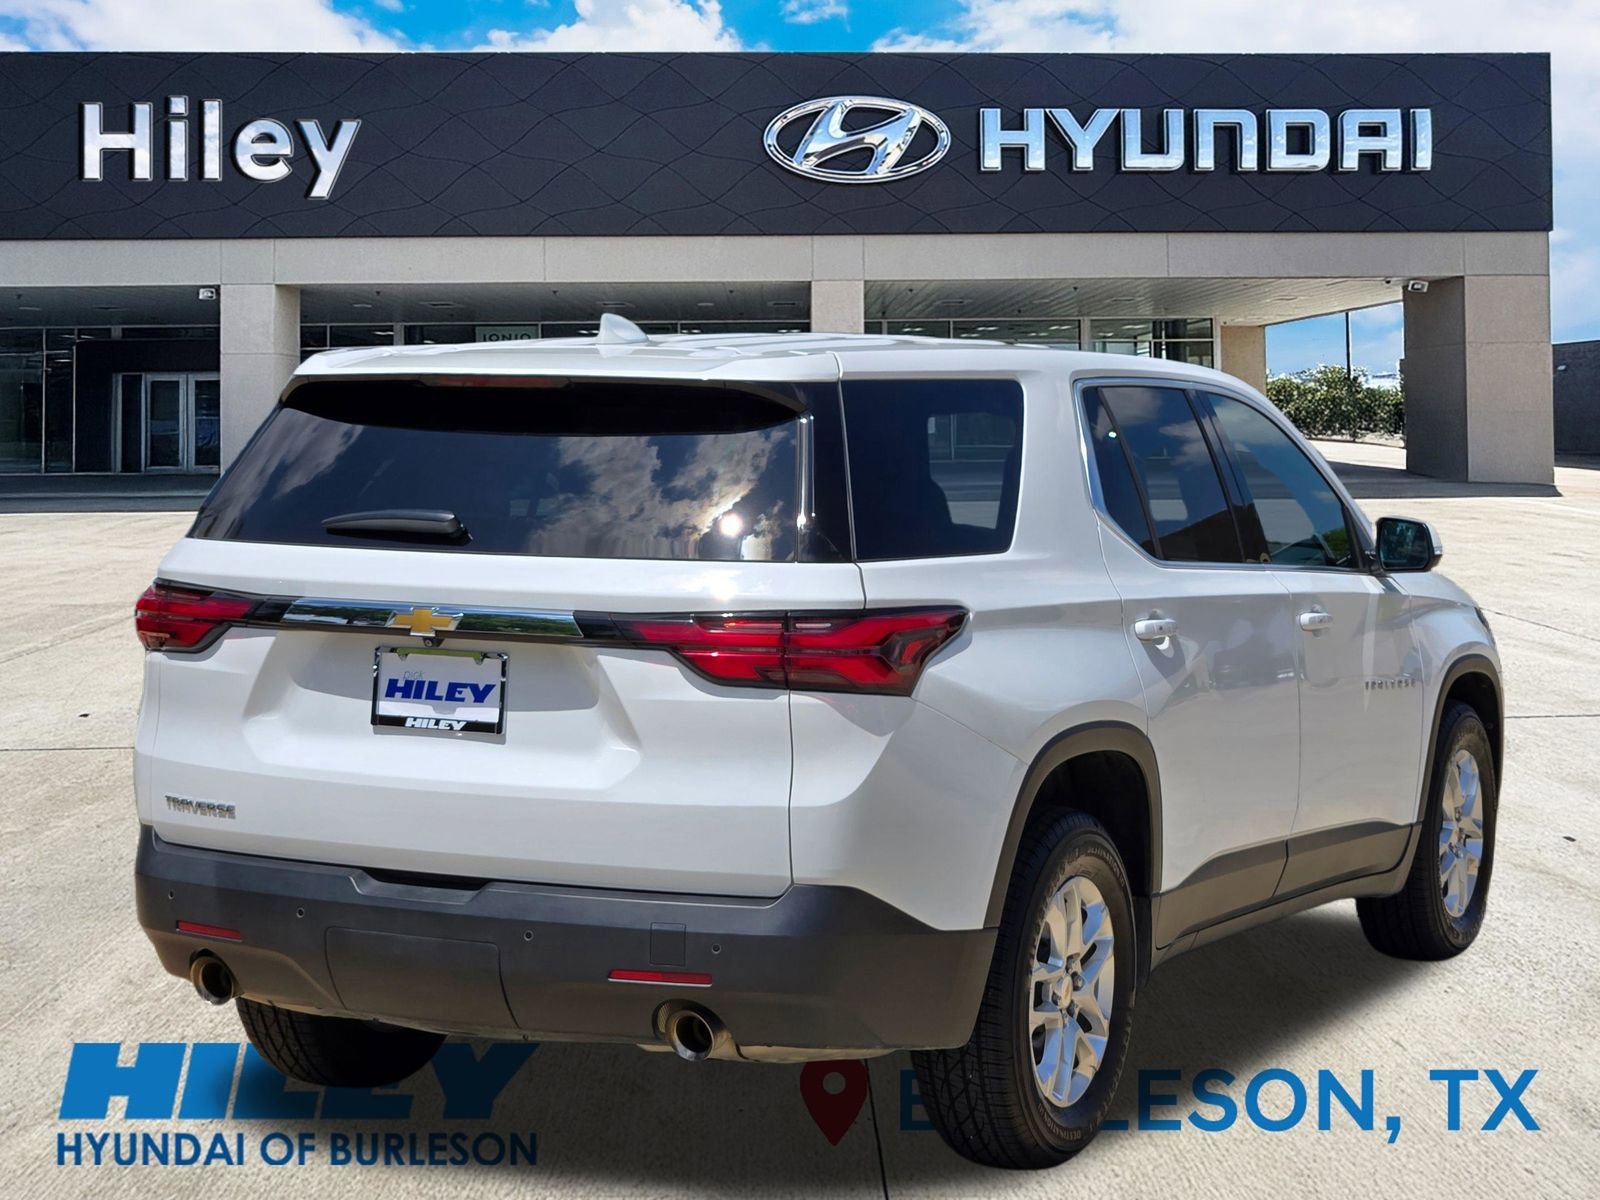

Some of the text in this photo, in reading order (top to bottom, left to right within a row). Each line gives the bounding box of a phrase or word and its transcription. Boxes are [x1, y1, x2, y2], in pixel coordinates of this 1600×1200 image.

[80, 95, 361, 200] Hiley
[979, 107, 1432, 172] HYUNDAI
[384, 678, 496, 703] HILEY
[404, 717, 467, 731] HILEY
[165, 795, 236, 819] TRAVERSE
